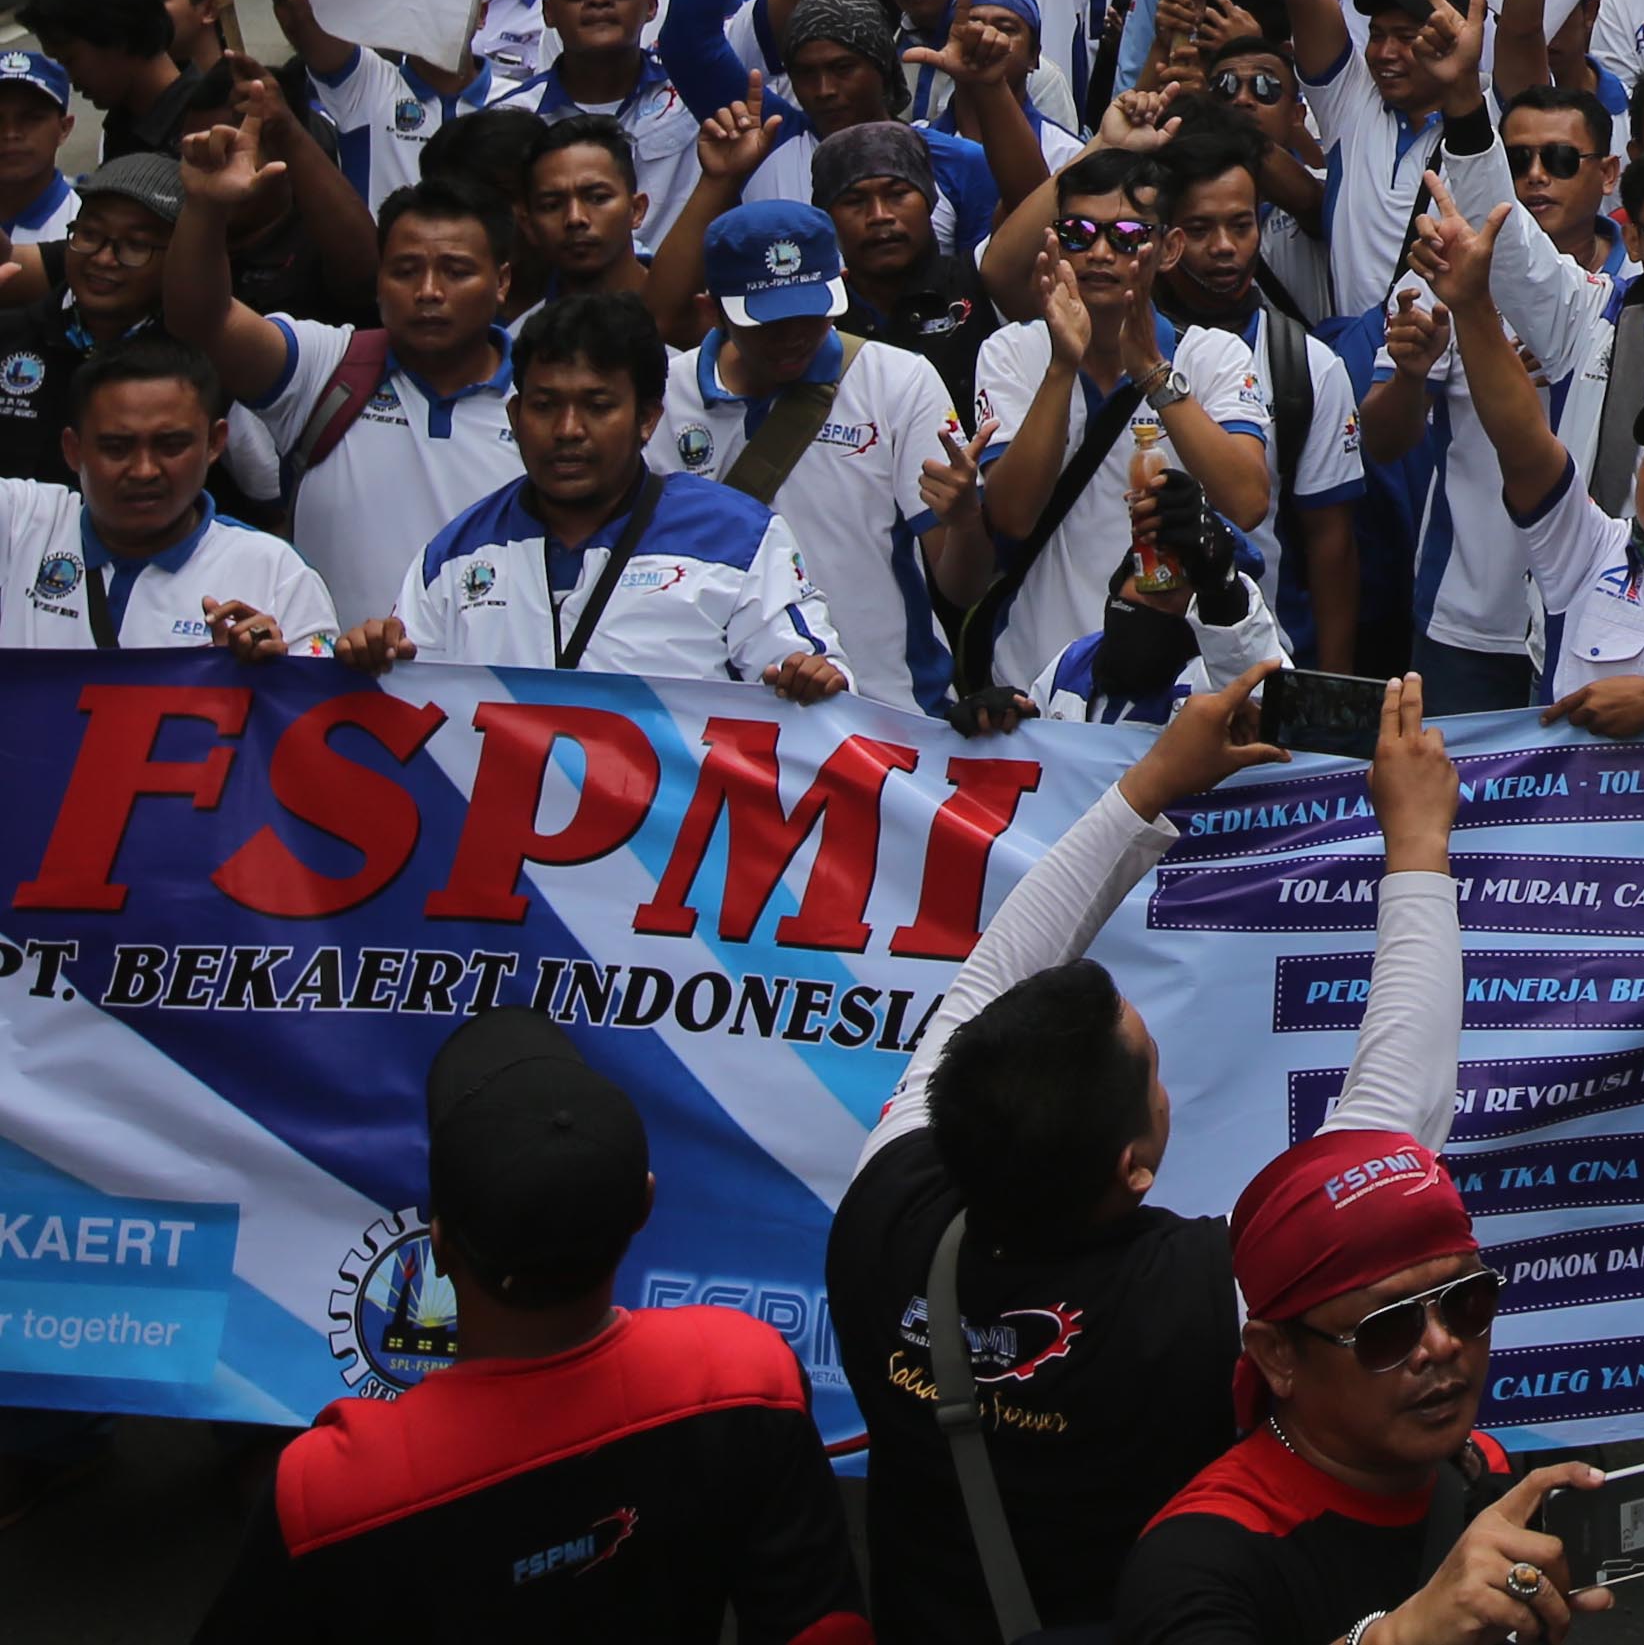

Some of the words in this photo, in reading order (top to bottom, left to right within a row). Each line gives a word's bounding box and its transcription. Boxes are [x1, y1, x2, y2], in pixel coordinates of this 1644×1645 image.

[620, 571, 664, 589] FSPMI
[1482, 773, 1570, 802] KERJA
[12, 682, 1041, 961] FSPMI
[1189, 798, 1329, 837] SEDIAKAN
[1277, 878, 1379, 903] TOLAK
[1480, 877, 1603, 912] MURAH,
[102, 942, 521, 1018] BEKAERT
[1464, 976, 1600, 1004] KINERJA
[1483, 1068, 1634, 1114] REVOLUSI
[1323, 1152, 1422, 1203] FSPMI
[1499, 1163, 1557, 1189] TKA
[1567, 1156, 1641, 1185] CINA
[1512, 1254, 1598, 1285] POKOK
[22, 1308, 181, 1349] together
[1490, 1366, 1591, 1402] CALEG
[513, 1534, 596, 1584] FSPMI
